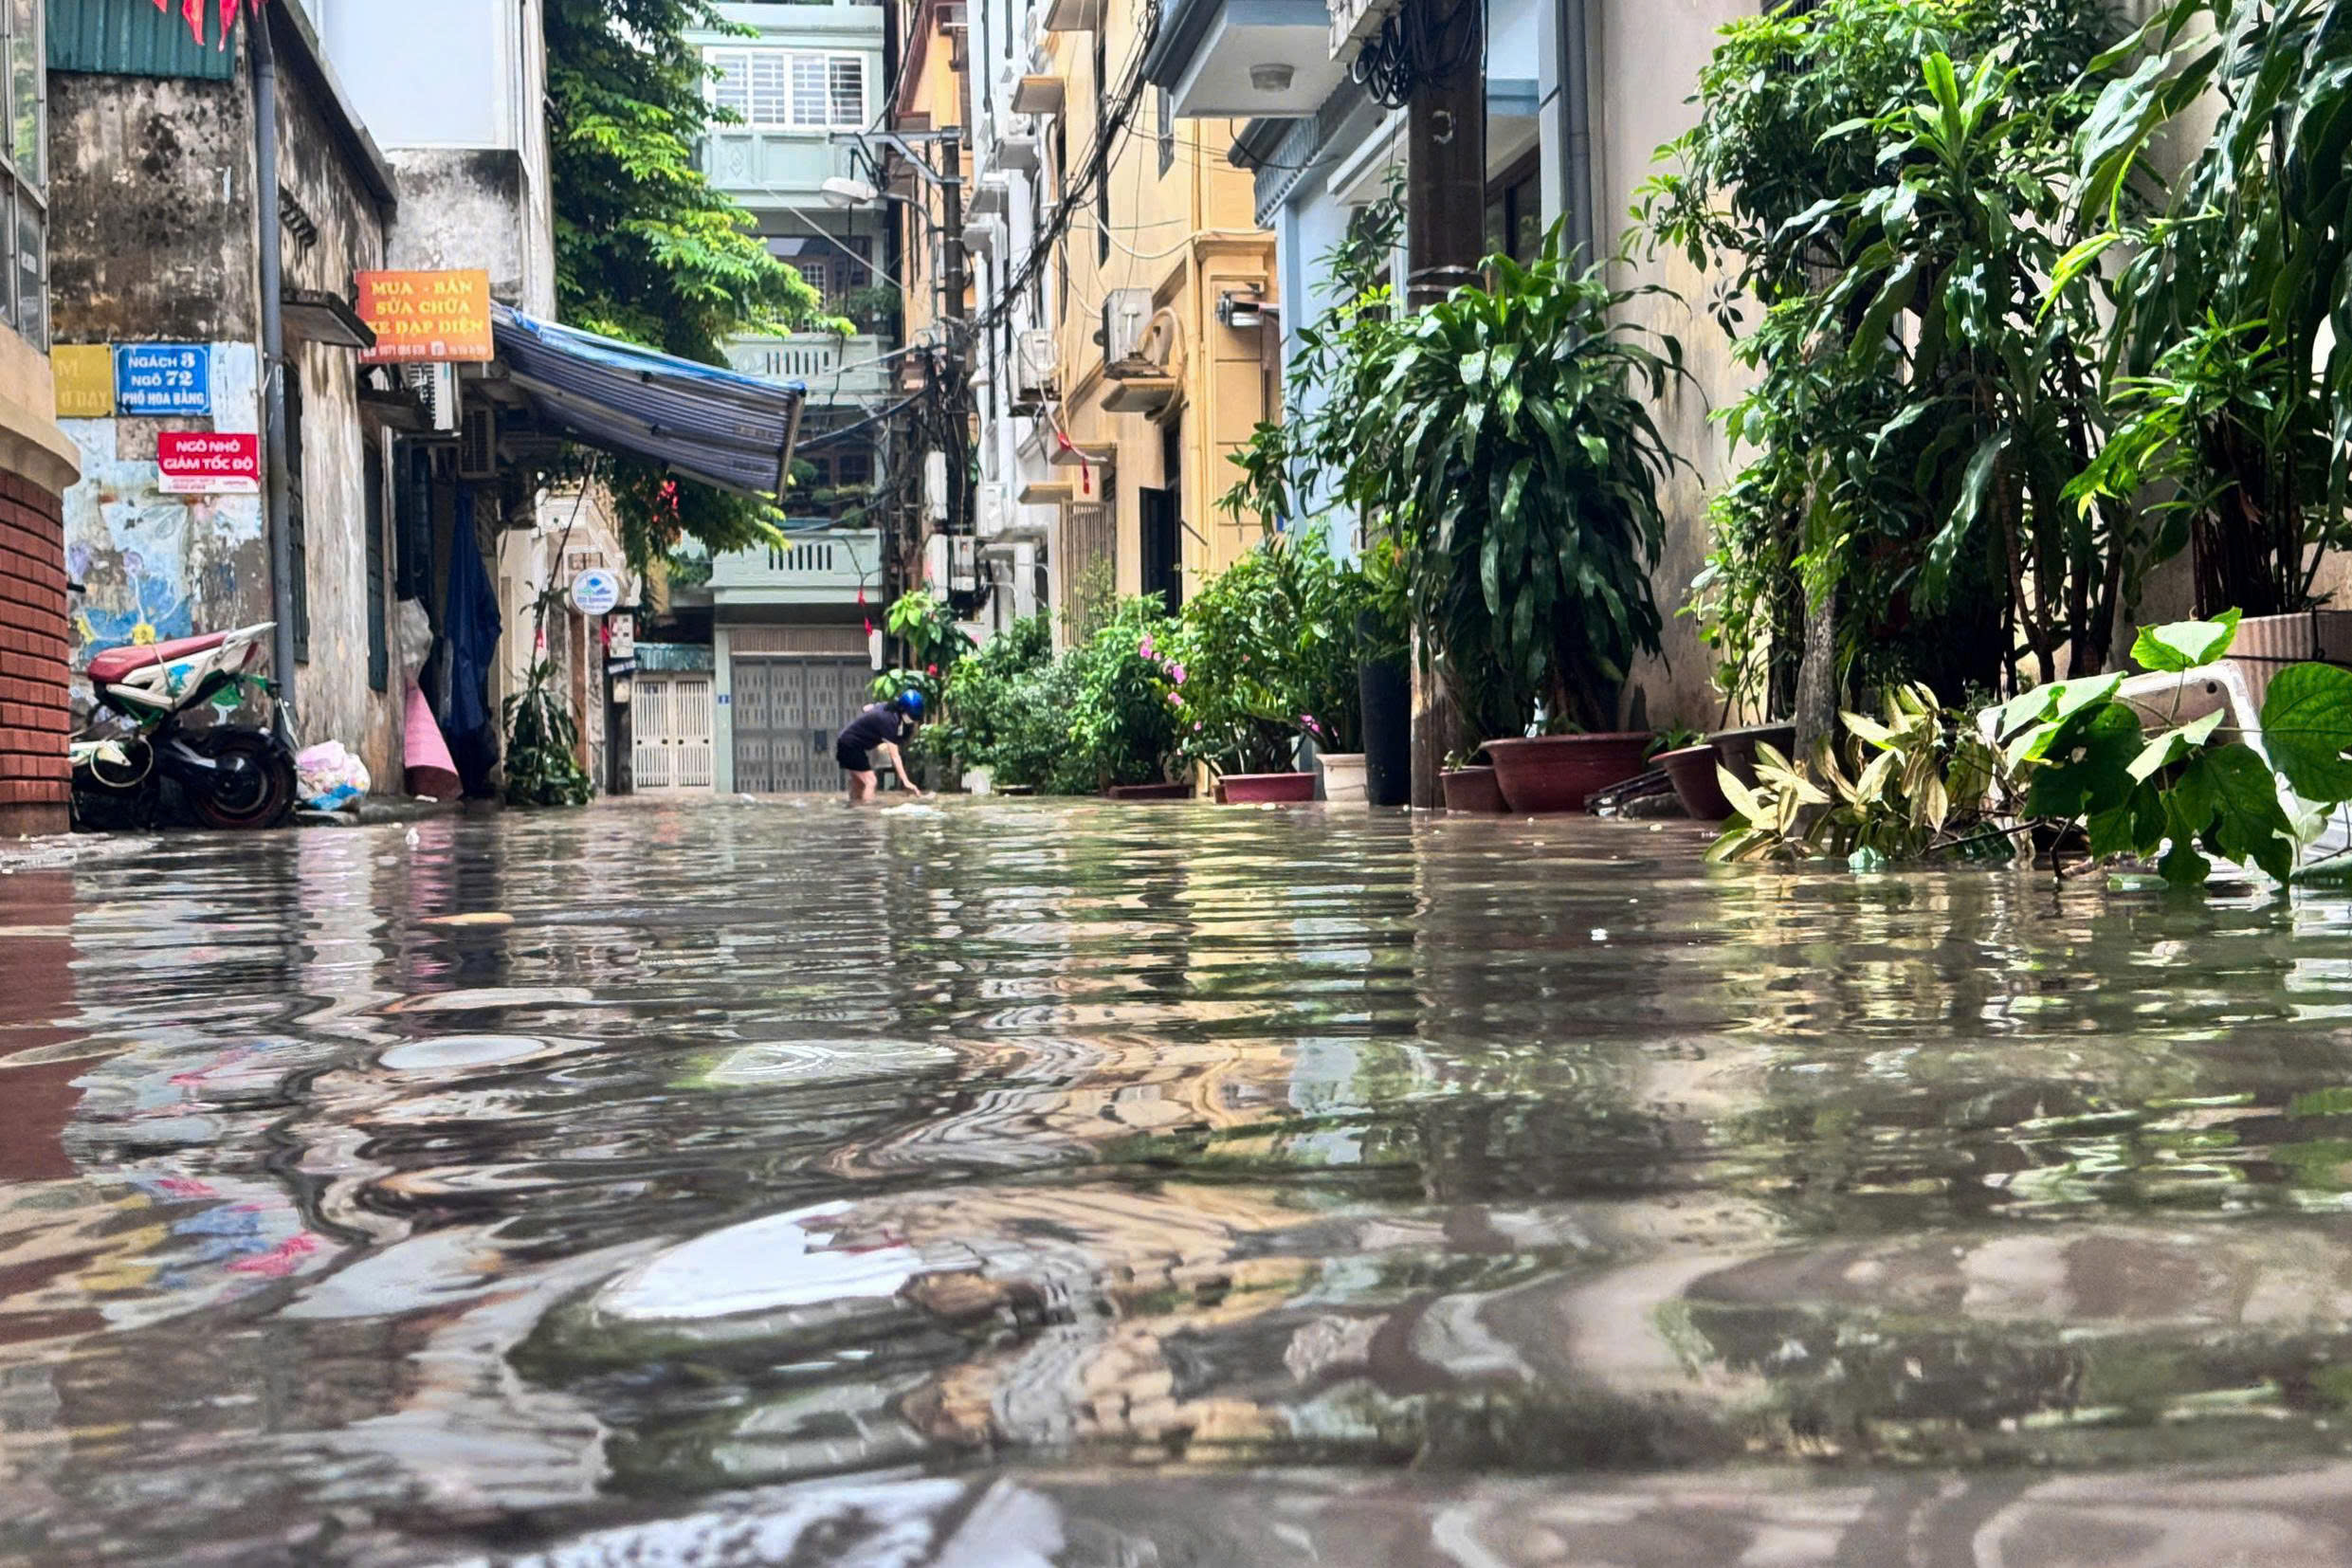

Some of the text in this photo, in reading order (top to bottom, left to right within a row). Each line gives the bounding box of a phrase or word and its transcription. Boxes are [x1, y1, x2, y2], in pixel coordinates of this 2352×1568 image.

[372, 281, 413, 295] MUA
[434, 278, 472, 294] BÁN
[375, 297, 470, 315] SỬA CHỮA
[128, 355, 177, 368] NGÁCH
[131, 371, 193, 387] NGÕ 72
[121, 390, 144, 406] PHỐ
[147, 392, 171, 406] HOA
[175, 439, 207, 452] NGÕ
[163, 454, 254, 471] GIẢM TỐC ĐỘ
